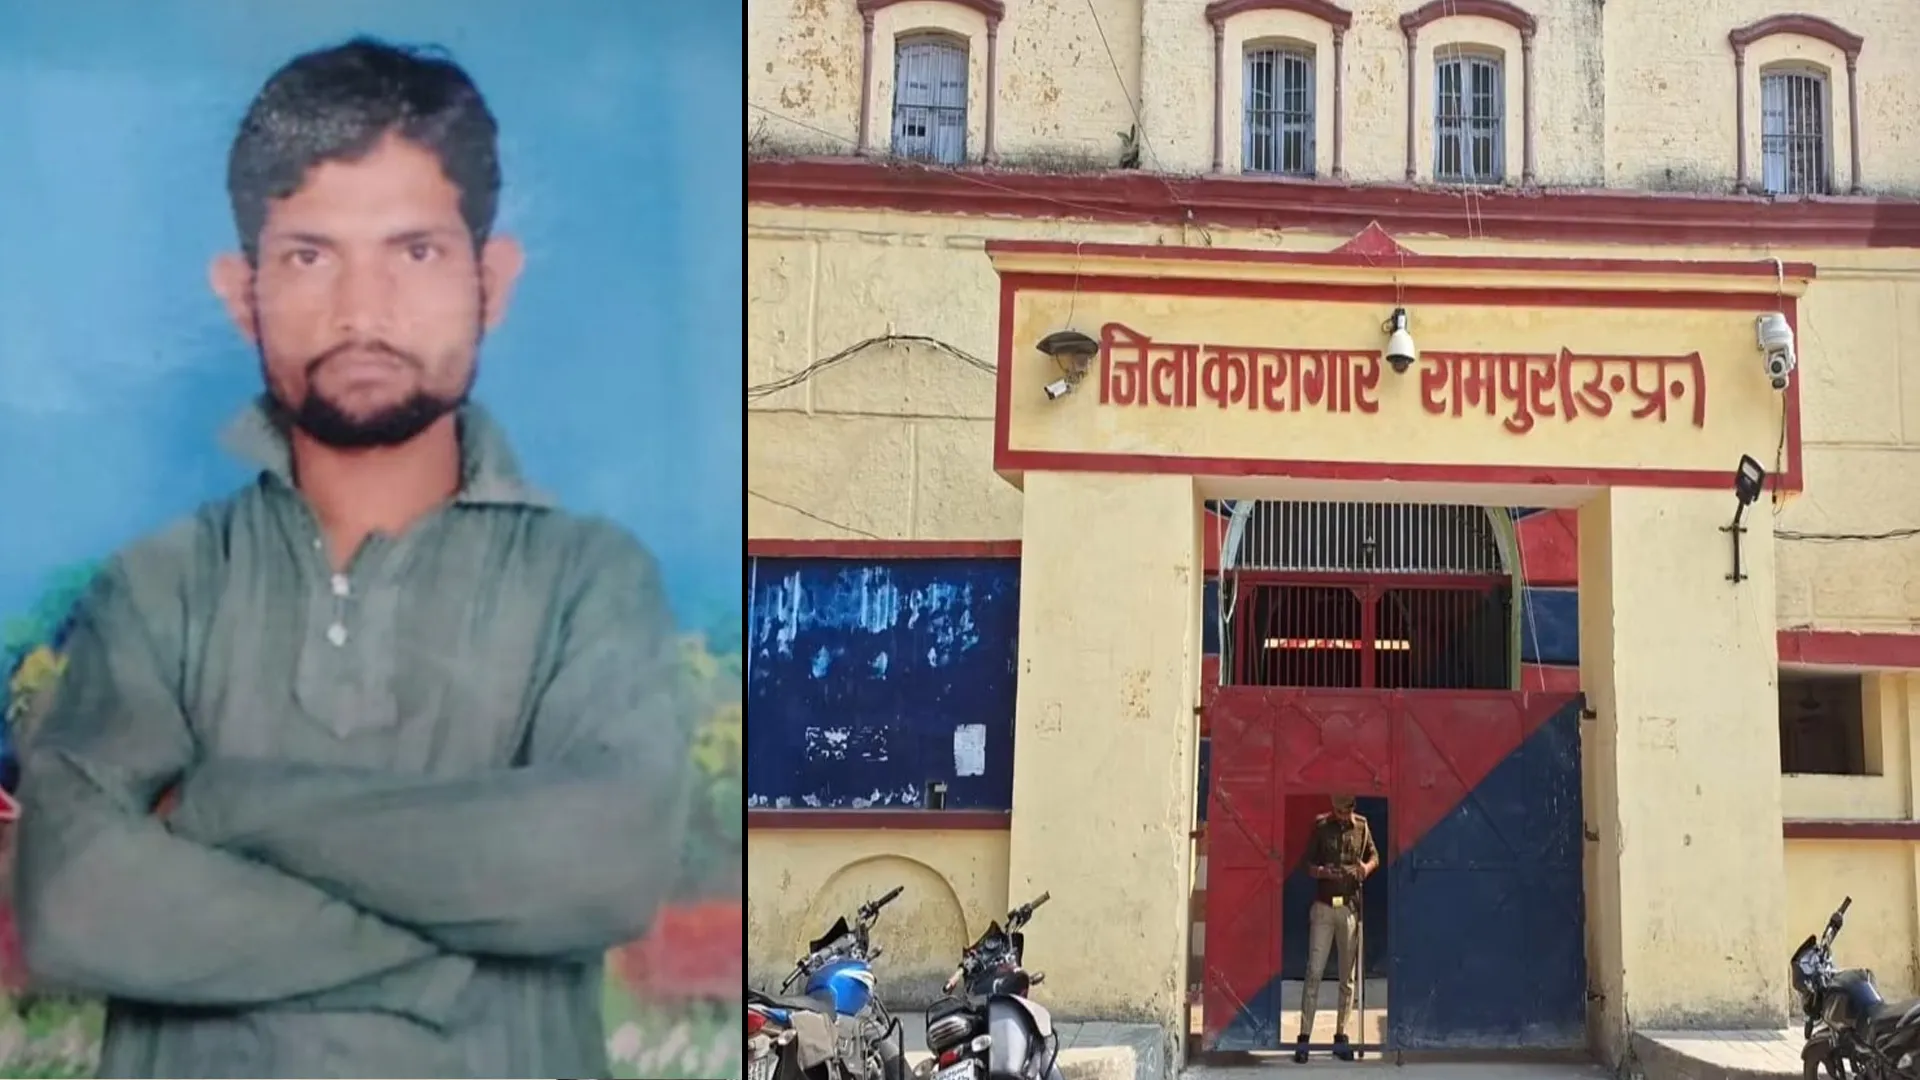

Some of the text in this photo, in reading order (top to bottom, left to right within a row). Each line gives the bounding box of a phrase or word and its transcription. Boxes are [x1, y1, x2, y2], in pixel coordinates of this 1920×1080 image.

[1099, 322, 1199, 407] जिला
[1202, 344, 1382, 413] कारागार
[1419, 351, 1557, 434] रामपुर
